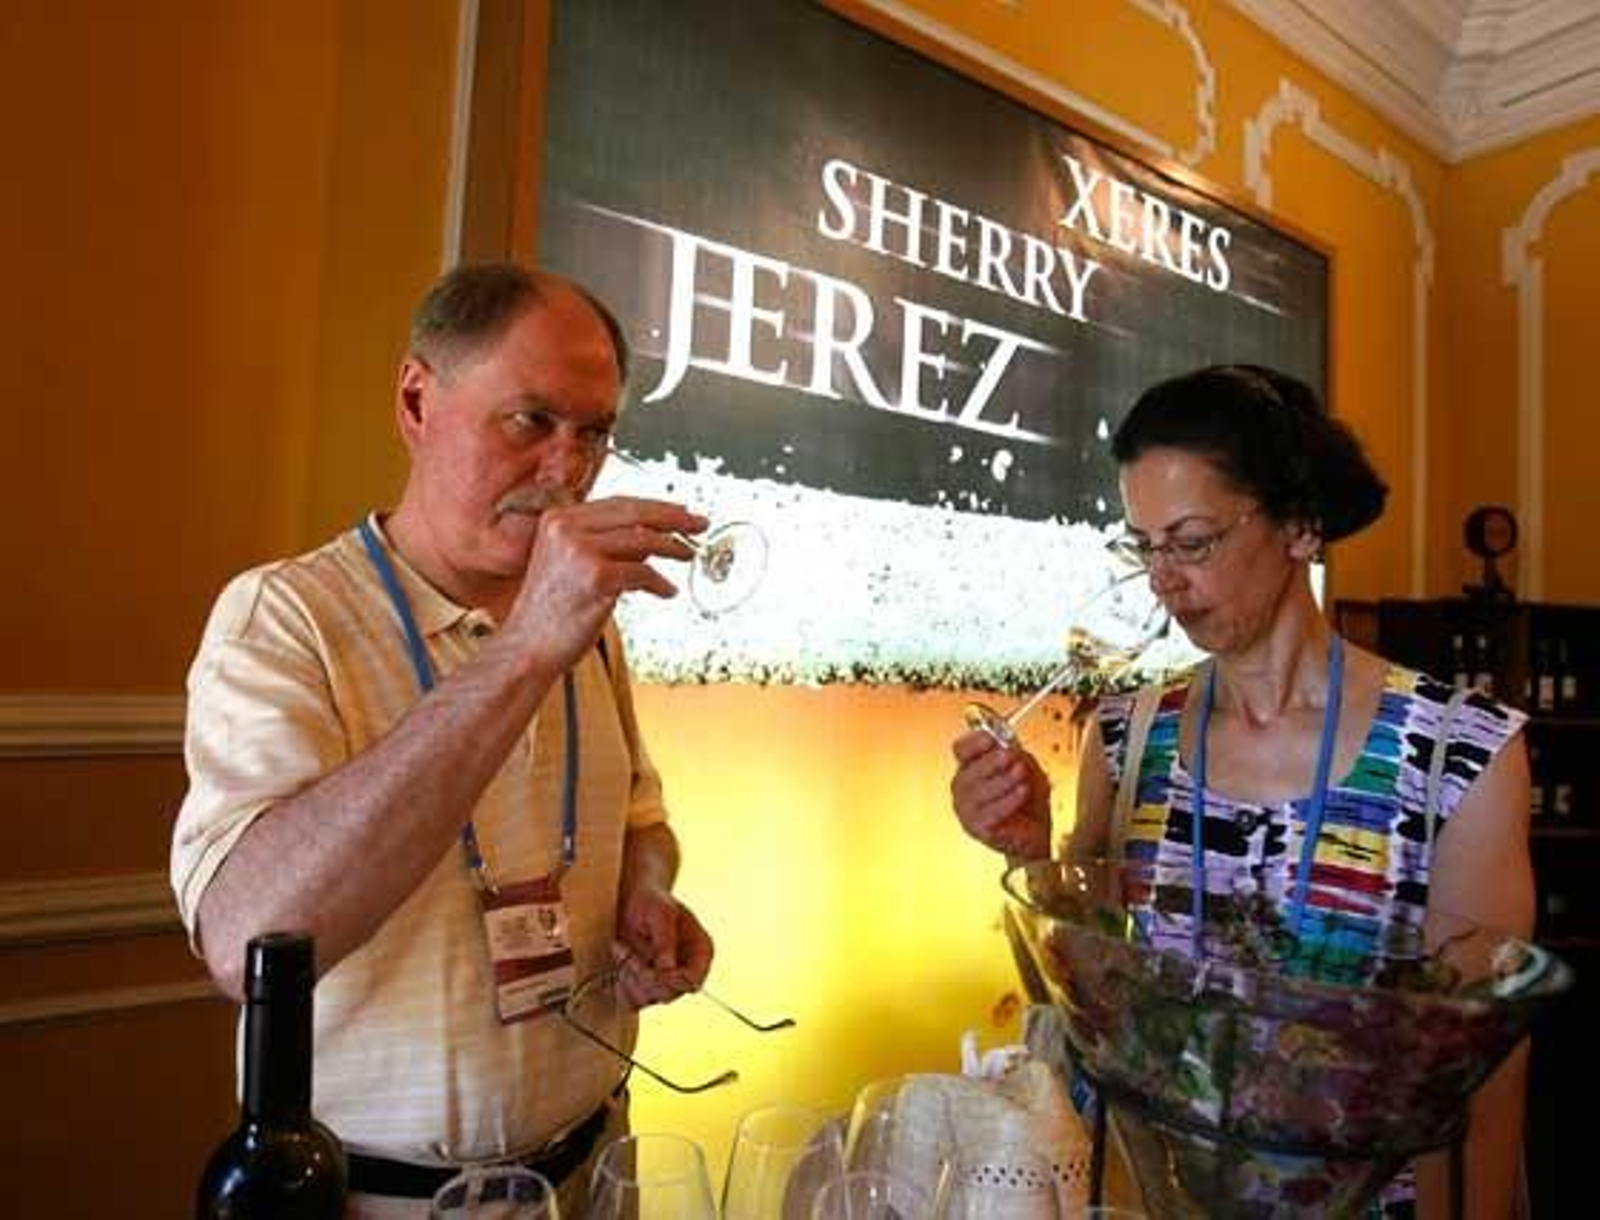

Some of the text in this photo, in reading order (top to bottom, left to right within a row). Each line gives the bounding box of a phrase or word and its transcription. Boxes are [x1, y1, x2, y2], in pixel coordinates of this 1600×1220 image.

[817, 159, 1100, 322] SHERRY
[1059, 156, 1231, 292] XERES
[643, 229, 1034, 440] JEREZ
